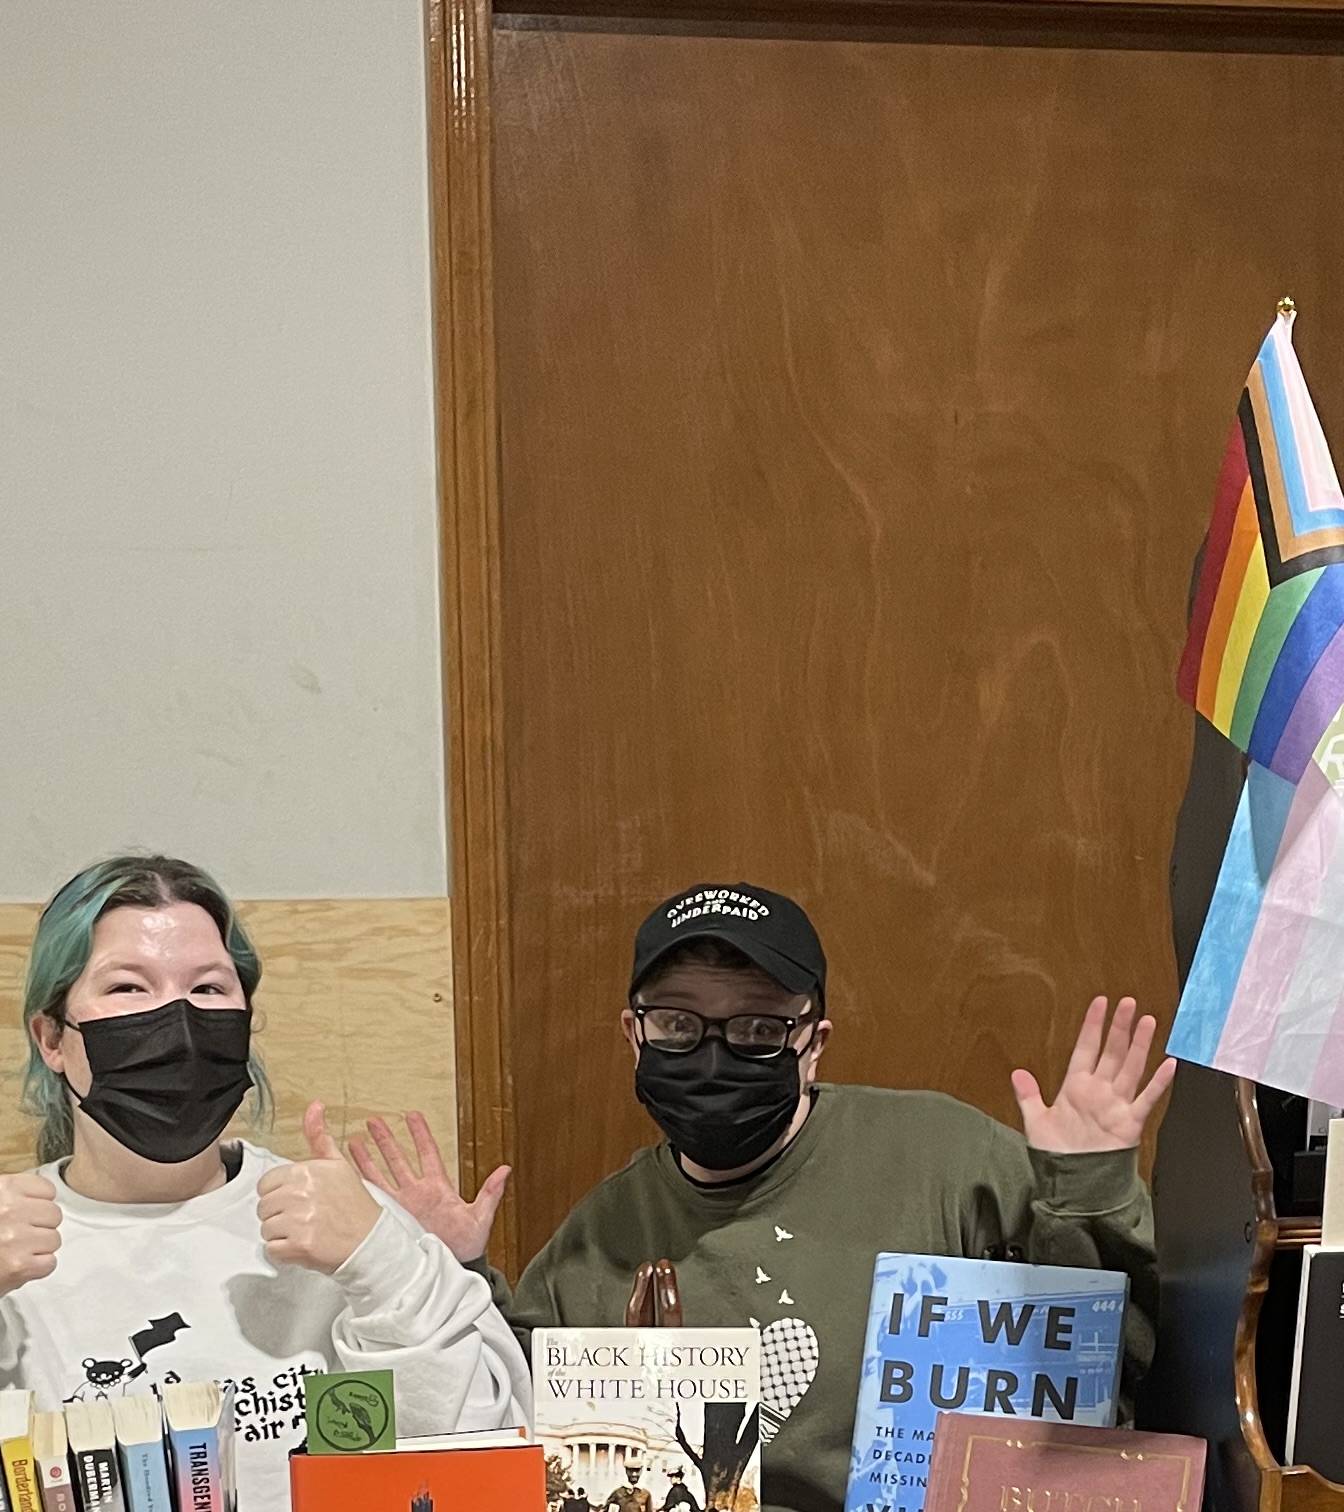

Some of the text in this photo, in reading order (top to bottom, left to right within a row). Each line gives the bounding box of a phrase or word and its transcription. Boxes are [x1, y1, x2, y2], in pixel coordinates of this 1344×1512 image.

[671, 903, 759, 928] UNDERPAID
[887, 1292, 1076, 1351] IF WE
[547, 1346, 630, 1367] BLACK
[547, 1378, 749, 1399] WHITE HOUSE
[878, 1359, 1079, 1421] BURN
[874, 1426, 905, 1440] THE
[97, 1460, 114, 1504] MARTIN
